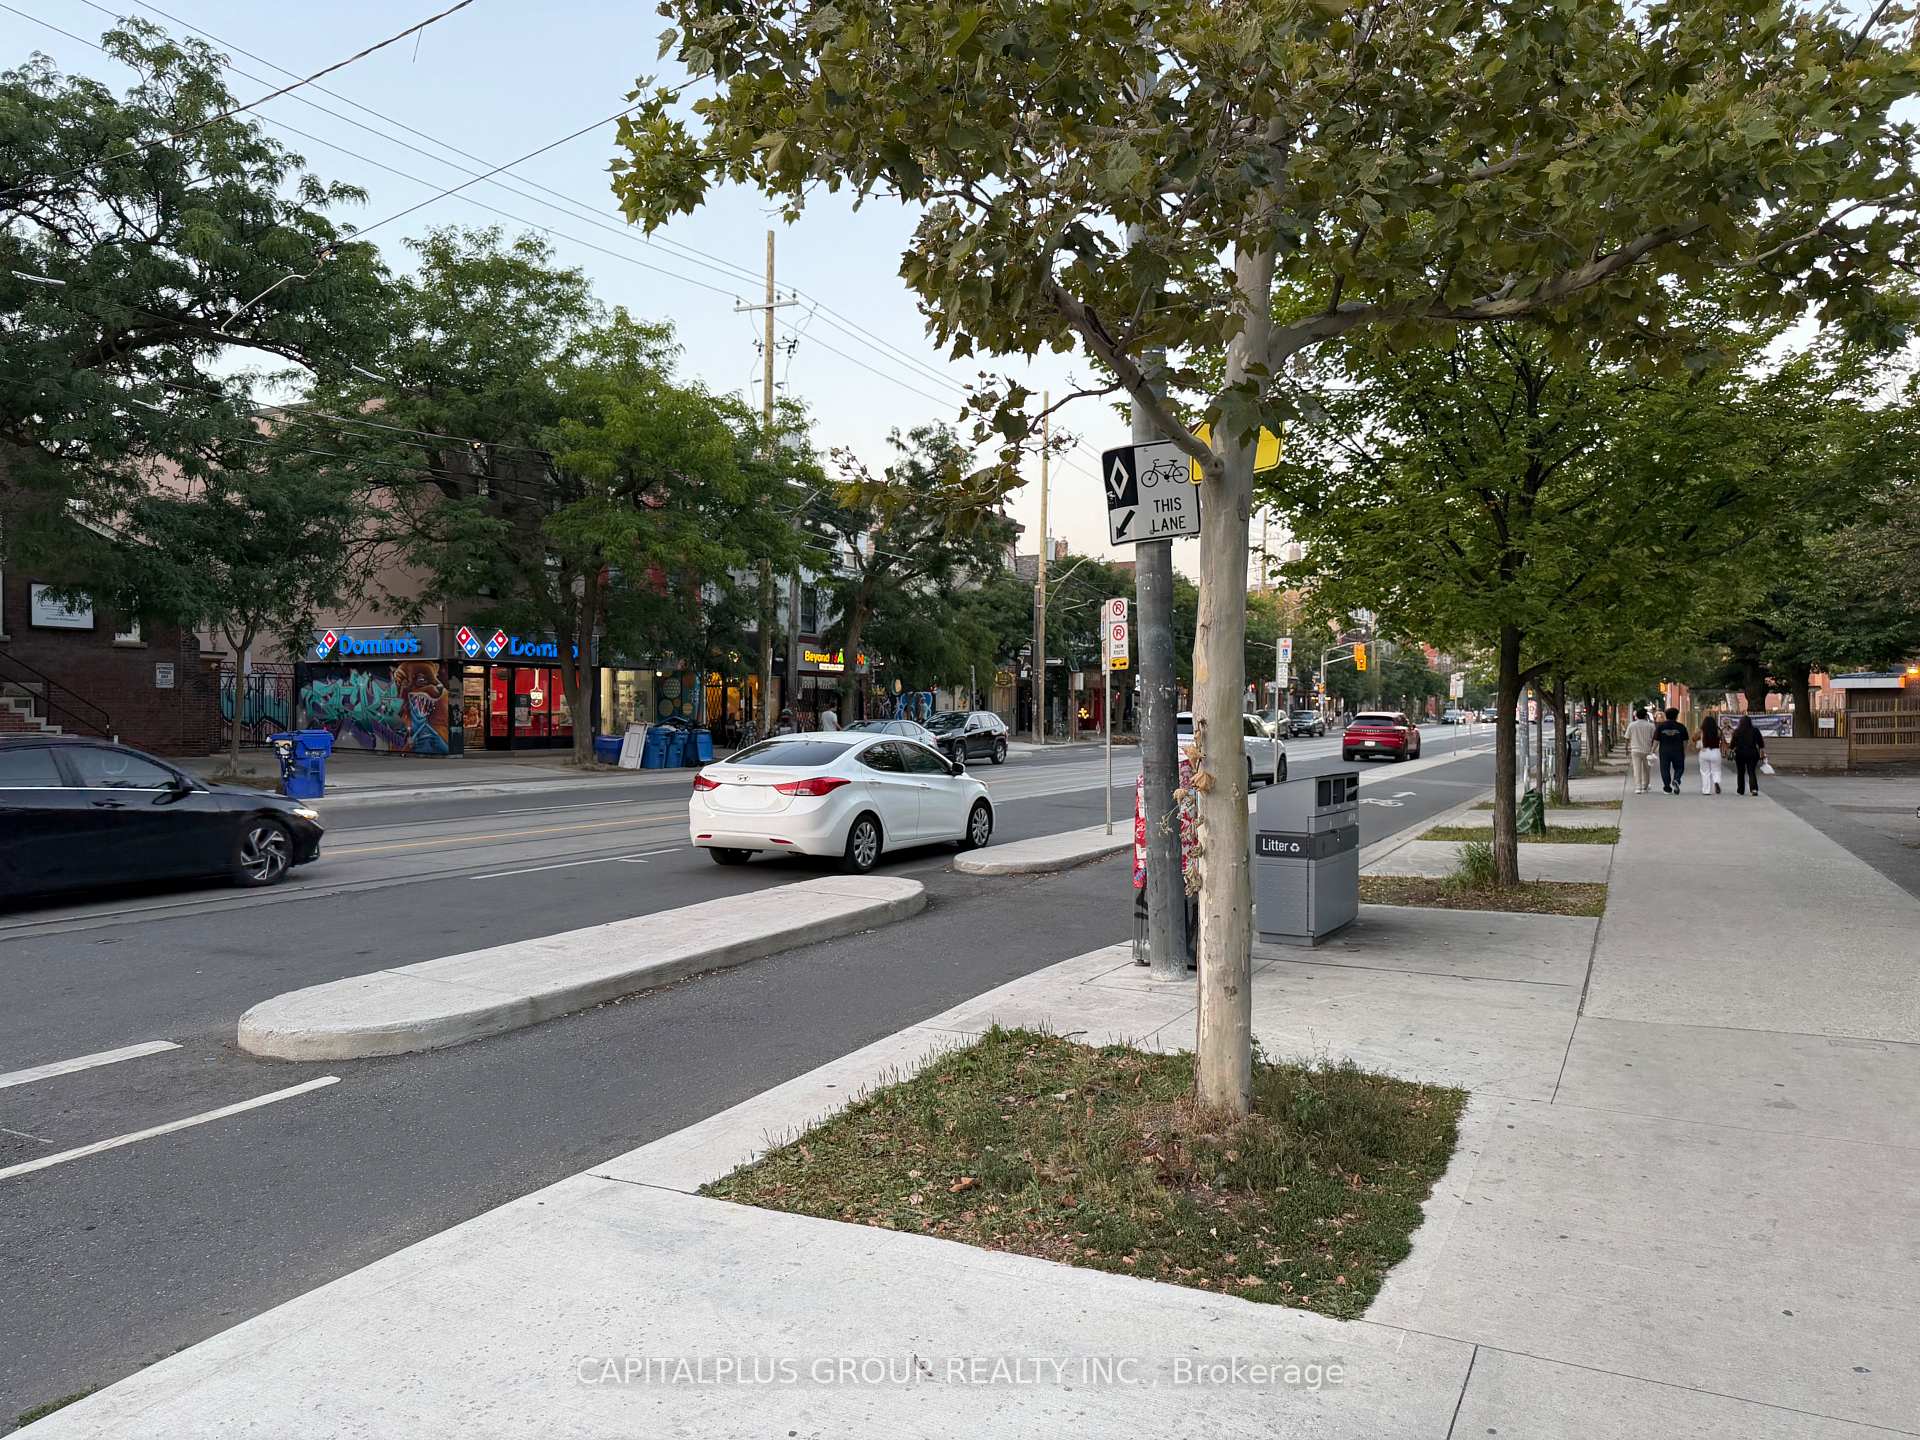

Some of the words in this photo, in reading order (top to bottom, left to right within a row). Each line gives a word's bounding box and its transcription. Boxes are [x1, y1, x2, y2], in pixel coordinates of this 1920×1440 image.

[1153, 497, 1182, 513] THIS
[1152, 515, 1186, 533] LANE
[804, 650, 830, 663] Beyond
[1262, 838, 1289, 852] Litter
